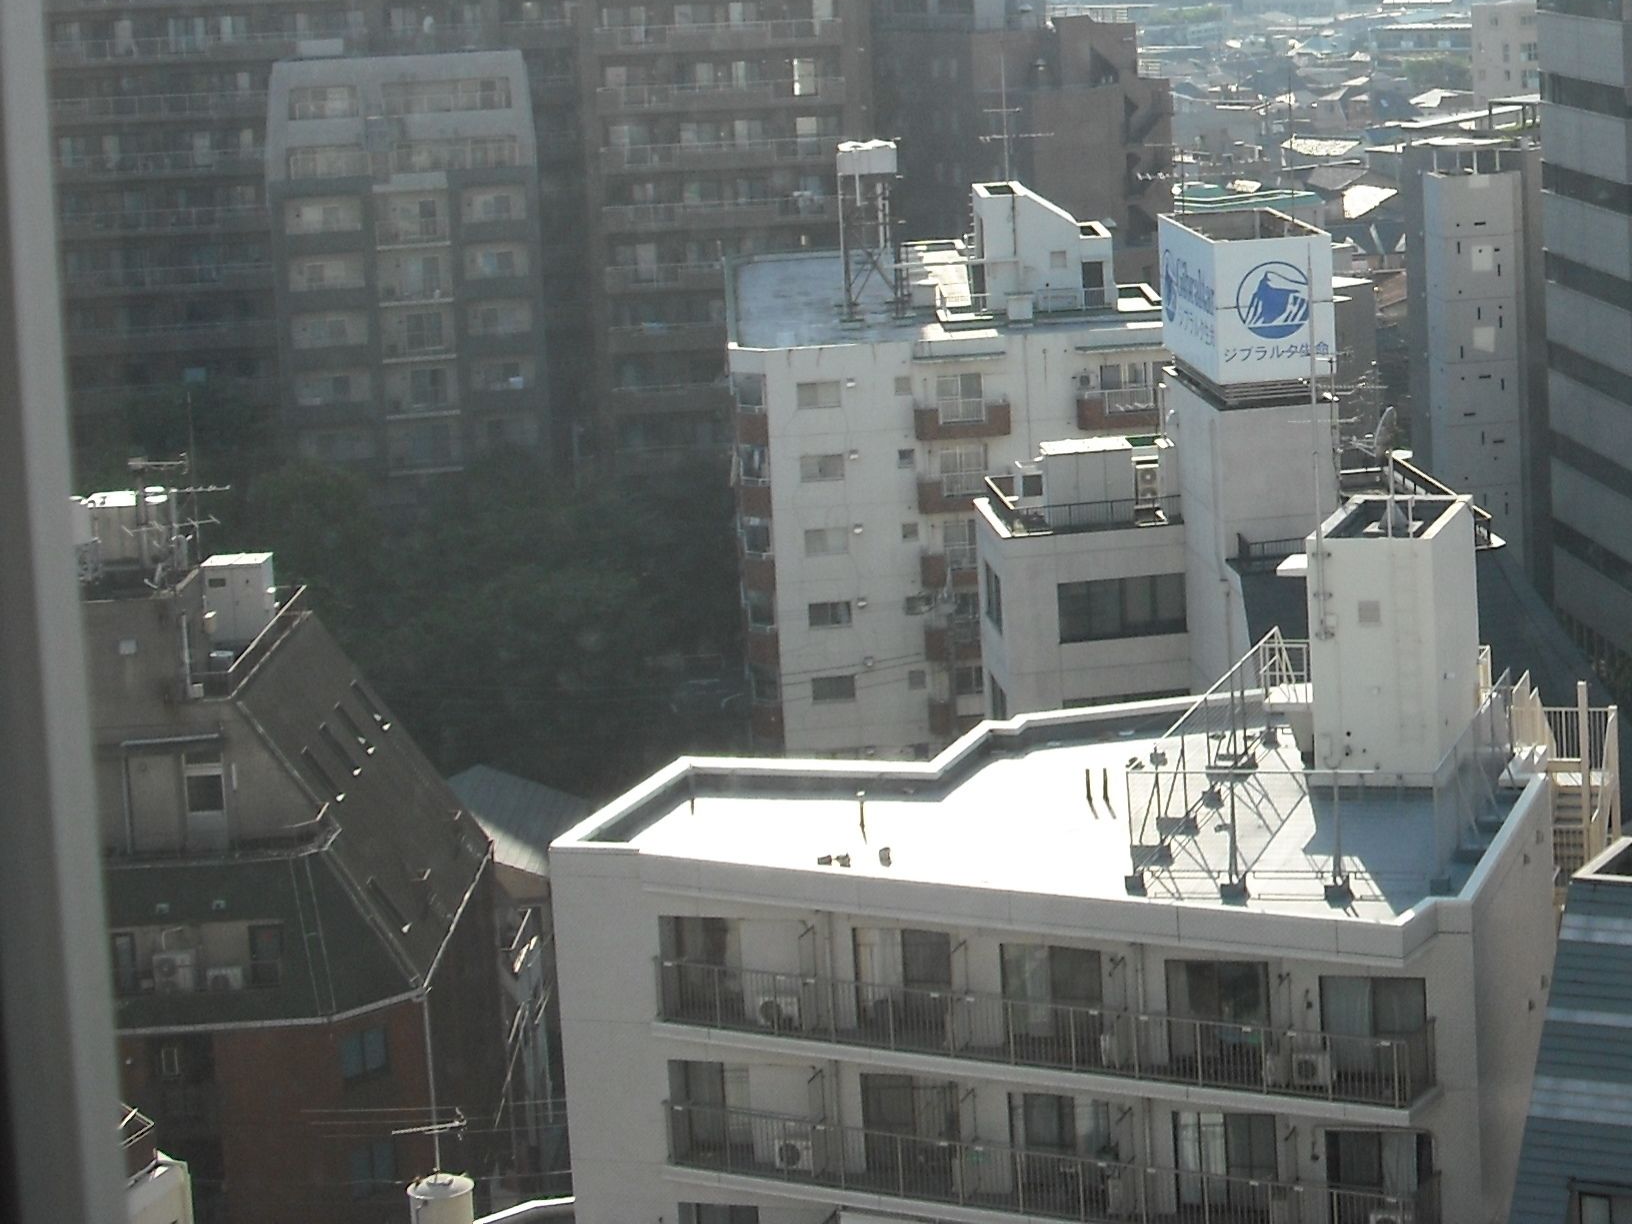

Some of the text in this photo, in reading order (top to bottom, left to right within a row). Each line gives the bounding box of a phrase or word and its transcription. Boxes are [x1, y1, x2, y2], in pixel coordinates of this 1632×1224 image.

[1223, 341, 1329, 363] ジブラルタ生命
